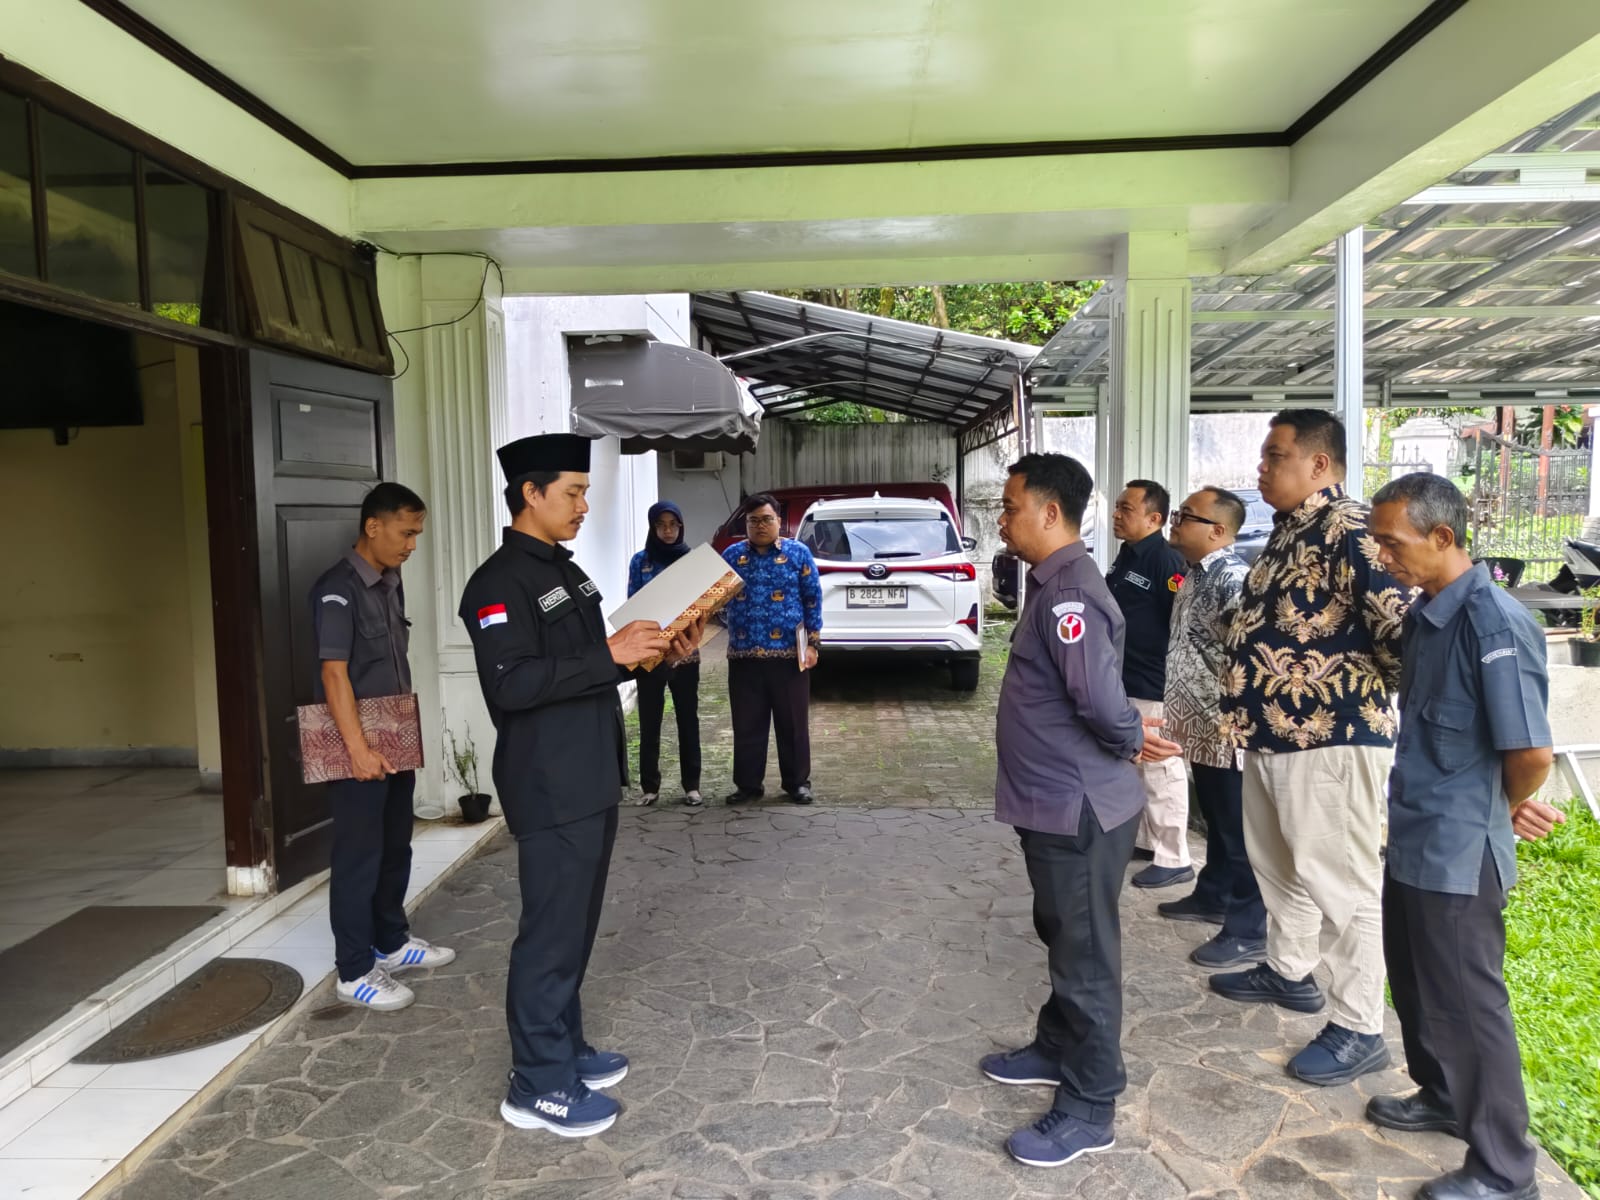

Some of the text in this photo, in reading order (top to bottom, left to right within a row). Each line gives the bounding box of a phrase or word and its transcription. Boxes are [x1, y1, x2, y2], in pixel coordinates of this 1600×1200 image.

[849, 589, 905, 599] B 2821 NFA
[535, 1099, 569, 1118] HOKA
